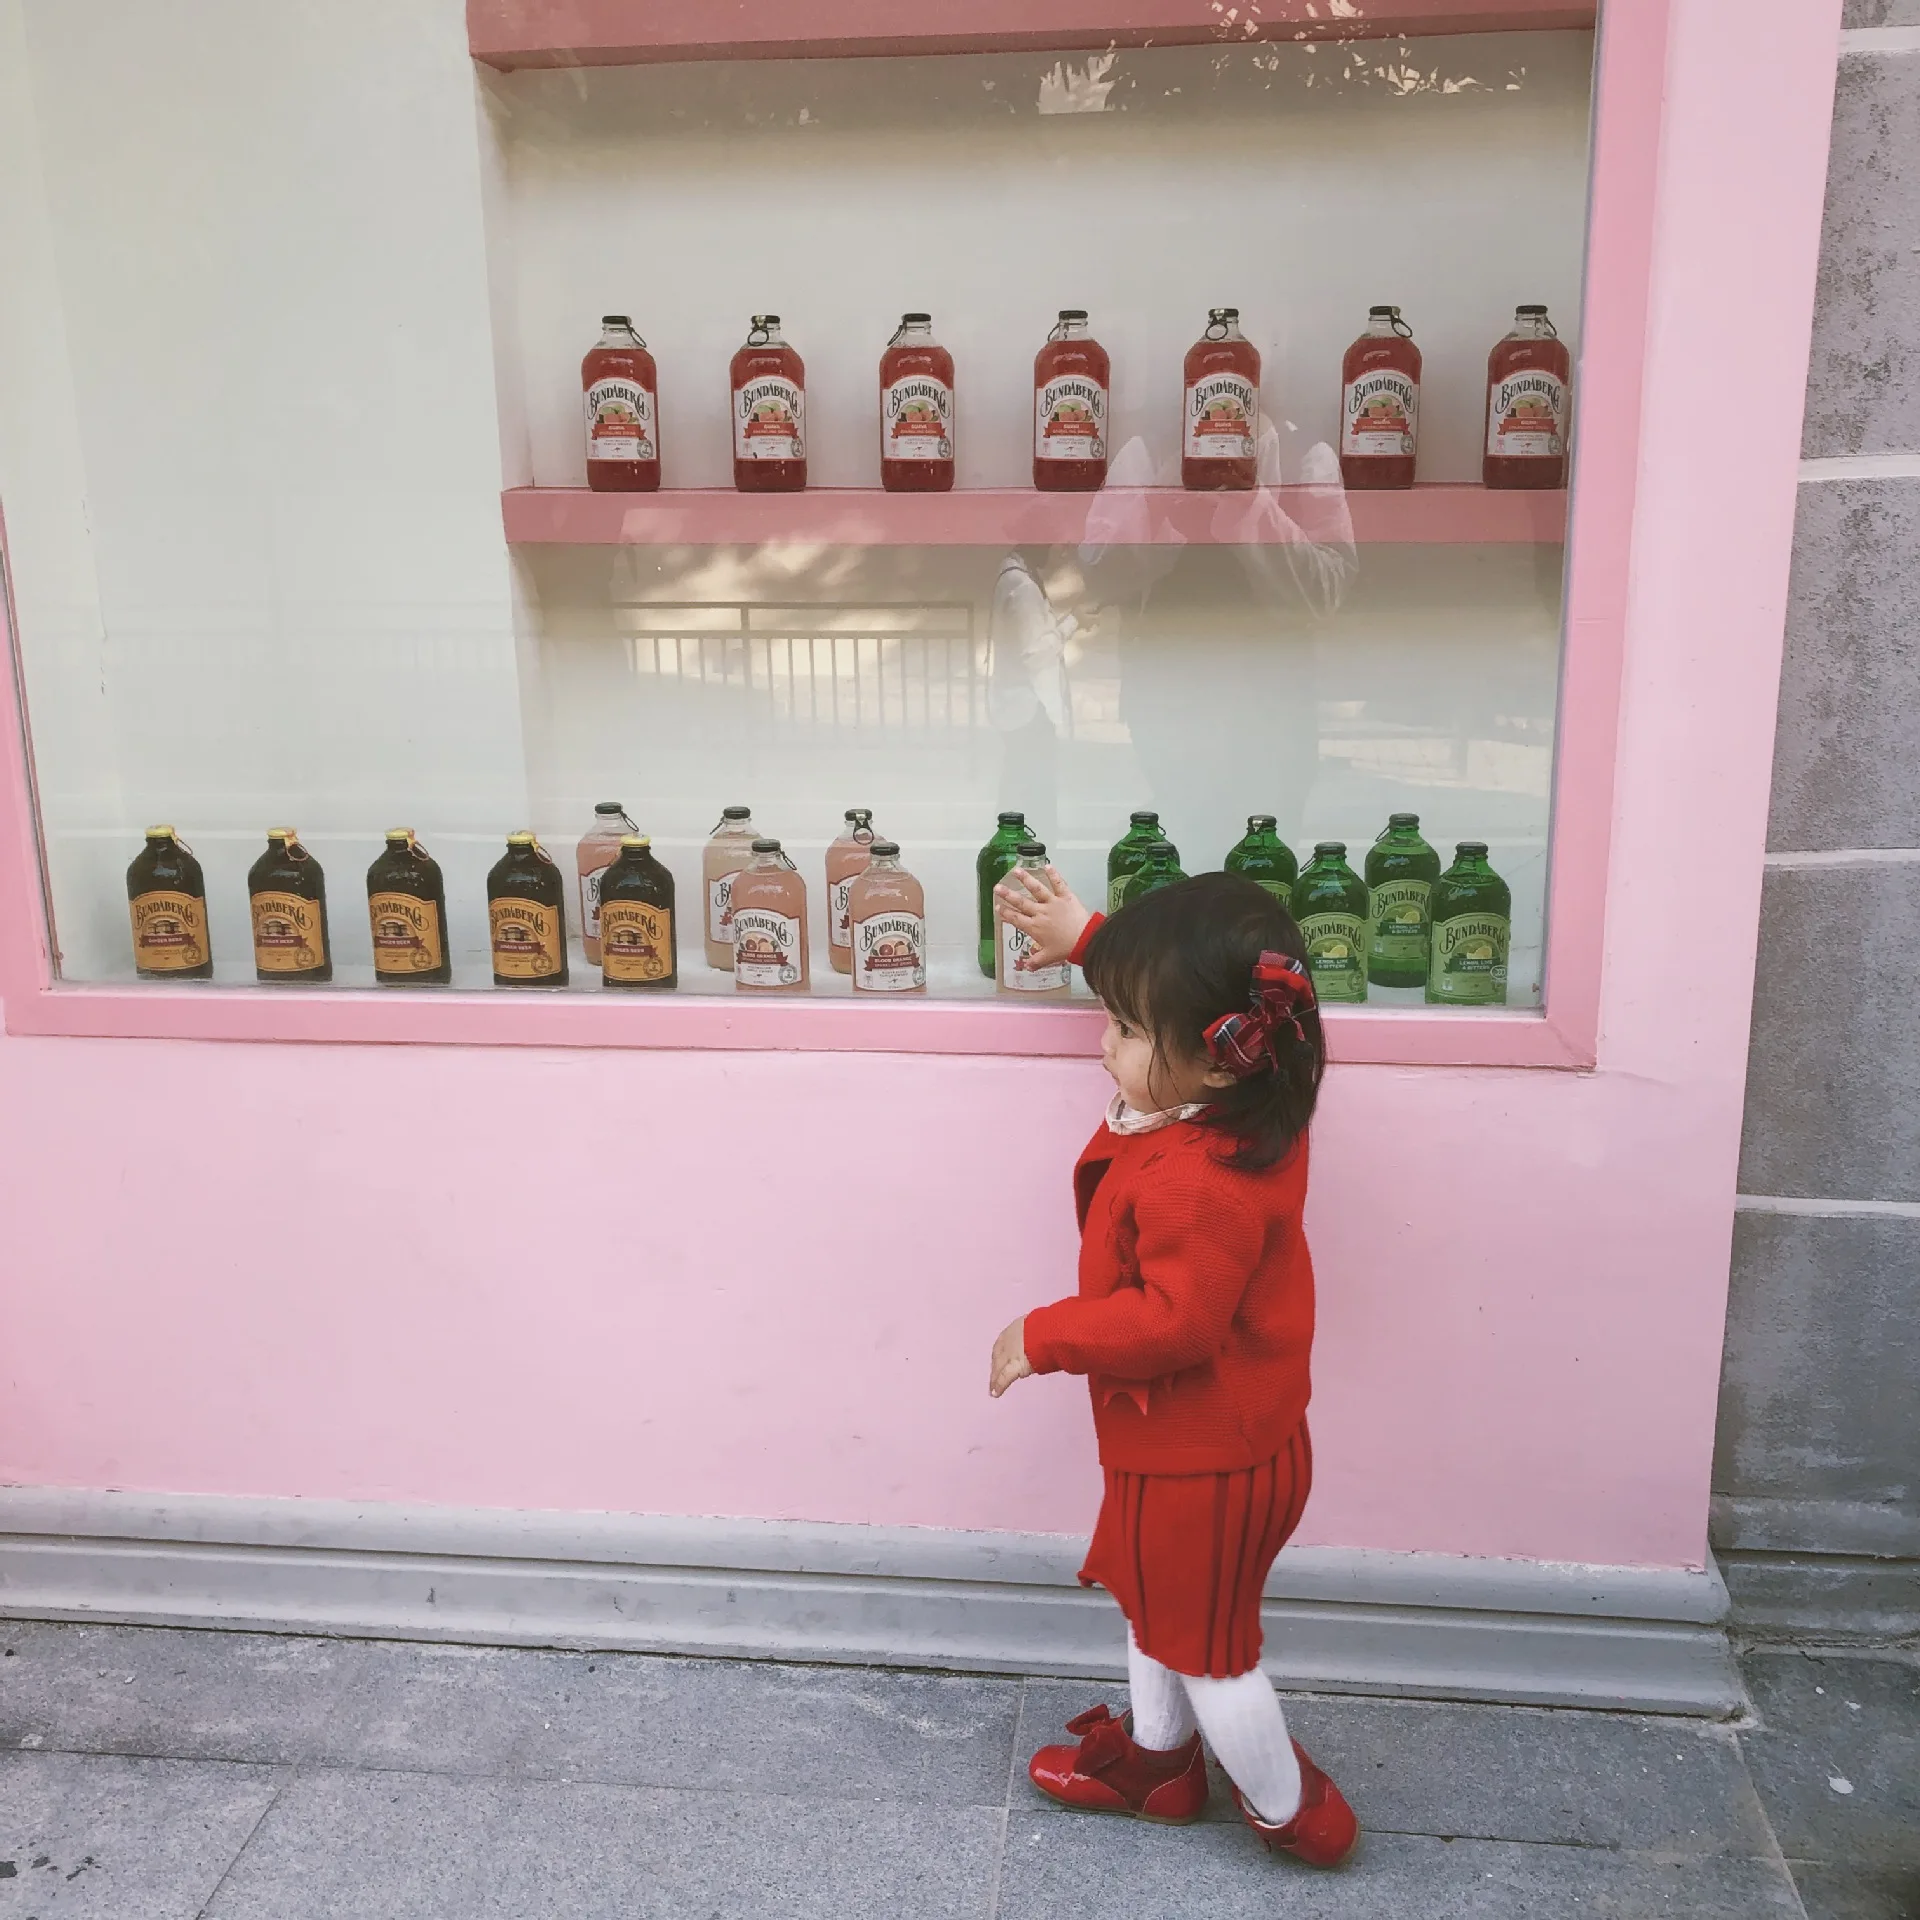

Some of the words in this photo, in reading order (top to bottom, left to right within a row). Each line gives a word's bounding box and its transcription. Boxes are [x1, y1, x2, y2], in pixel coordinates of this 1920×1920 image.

[587, 384, 651, 420] BUNDABERG
[740, 383, 803, 419] BUNDABERG
[887, 382, 951, 419] BUNDABERG
[1040, 382, 1104, 418] BUNDABERG
[1191, 380, 1256, 417] BUNDABERG
[1348, 377, 1415, 414] BUNDABERG
[1495, 377, 1561, 414] BUNDABERG
[134, 901, 200, 930] BUNDABERG
[603, 909, 663, 940] BUNDABERG
[734, 915, 794, 946] BUNDABERG
[860, 919, 923, 951] BUNDABERG
[1303, 922, 1367, 953] BUNDABERG
[1439, 922, 1505, 954] BUNDABERG
